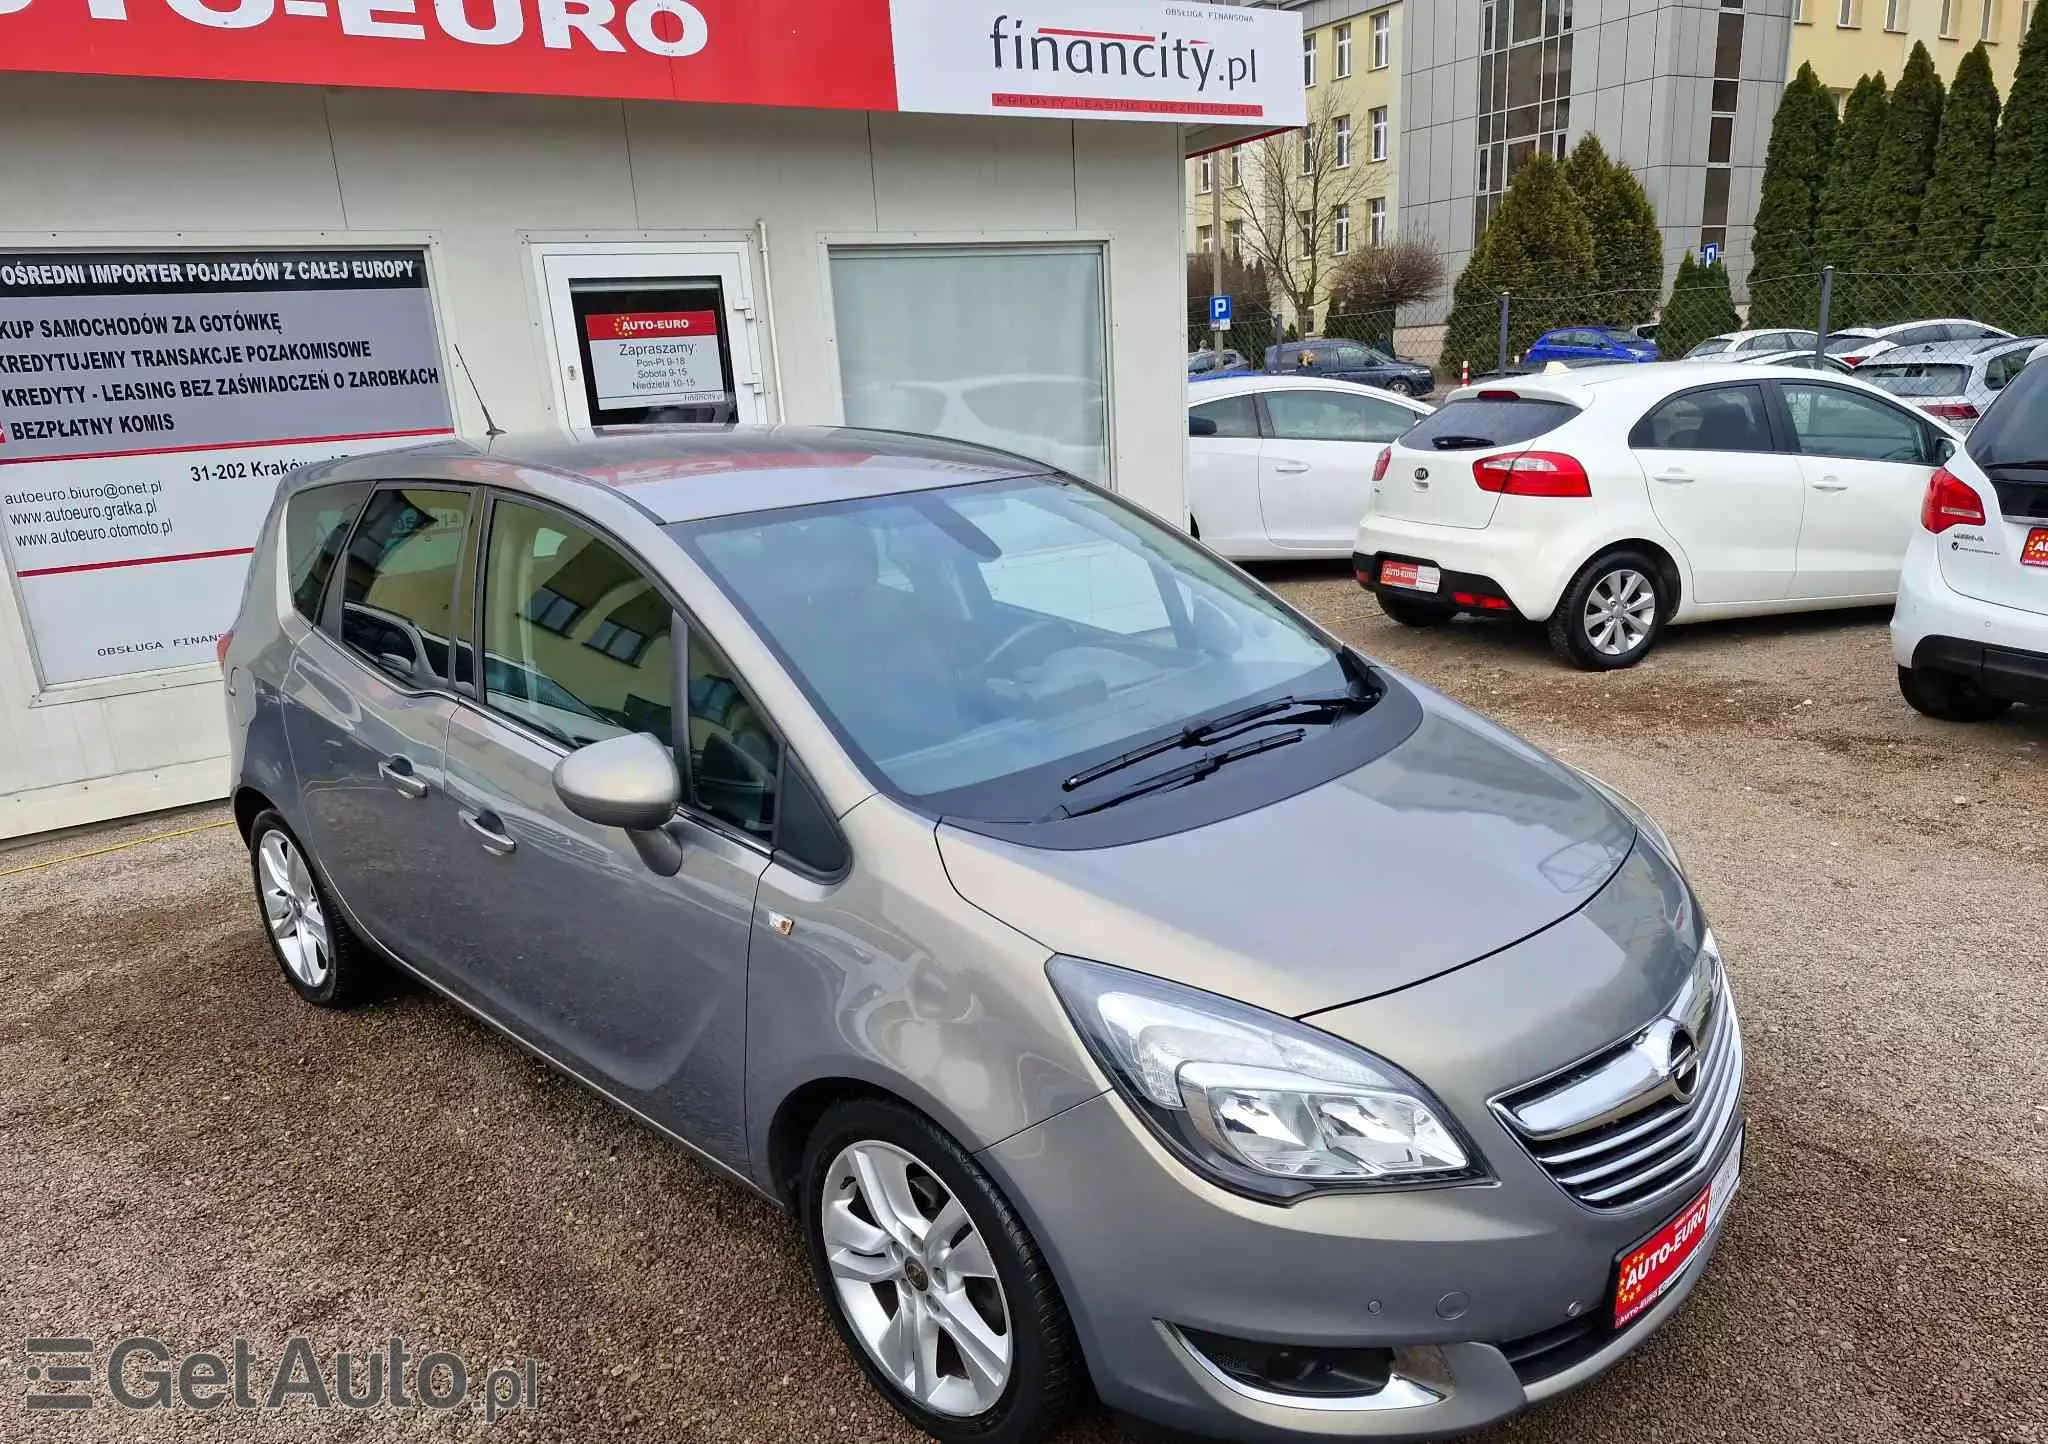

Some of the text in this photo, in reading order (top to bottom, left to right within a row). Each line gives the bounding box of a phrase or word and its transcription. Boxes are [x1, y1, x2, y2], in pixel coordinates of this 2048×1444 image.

[989, 15, 1257, 91] financity.pl
[89, 264, 184, 284] IMPORTER
[186, 258, 279, 283] POJAZDÓW
[283, 261, 296, 280] Z
[298, 261, 349, 280] CAŁEJ
[352, 260, 414, 279] EUROPY
[1215, 299, 1226, 318] P
[39, 313, 168, 338] SAMOCHODÓW
[172, 316, 196, 333] ZA
[199, 310, 282, 334] GOTÓWKĘ
[622, 319, 689, 331] AUTO-EURO
[0, 340, 372, 373] KREDYTUJEMY TRANSAKCJE POZAKOMISOWE
[2, 386, 86, 407] KREDYTY
[101, 381, 177, 402] LEASING
[180, 379, 214, 397] BEZ
[216, 370, 330, 396] ZAŚWIADCZEŃ
[333, 372, 345, 388] O
[348, 367, 440, 388] ZAROBKACH
[632, 381, 670, 390] Niedziela
[638, 370, 667, 379] Sobota
[10, 413, 175, 440] BEZPŁATNY KOMIS
[190, 458, 312, 482] 31-202 Krakó
[4, 480, 163, 505] autoeuro.biuro@onet.pl
[9, 499, 158, 526] www.autoeuro.gratka.pl
[15, 519, 174, 547] www.autoeuro.otomoto.pl
[97, 641, 164, 657] OBSŁUGA
[1625, 1203, 1706, 1291] AUTO-EURO
